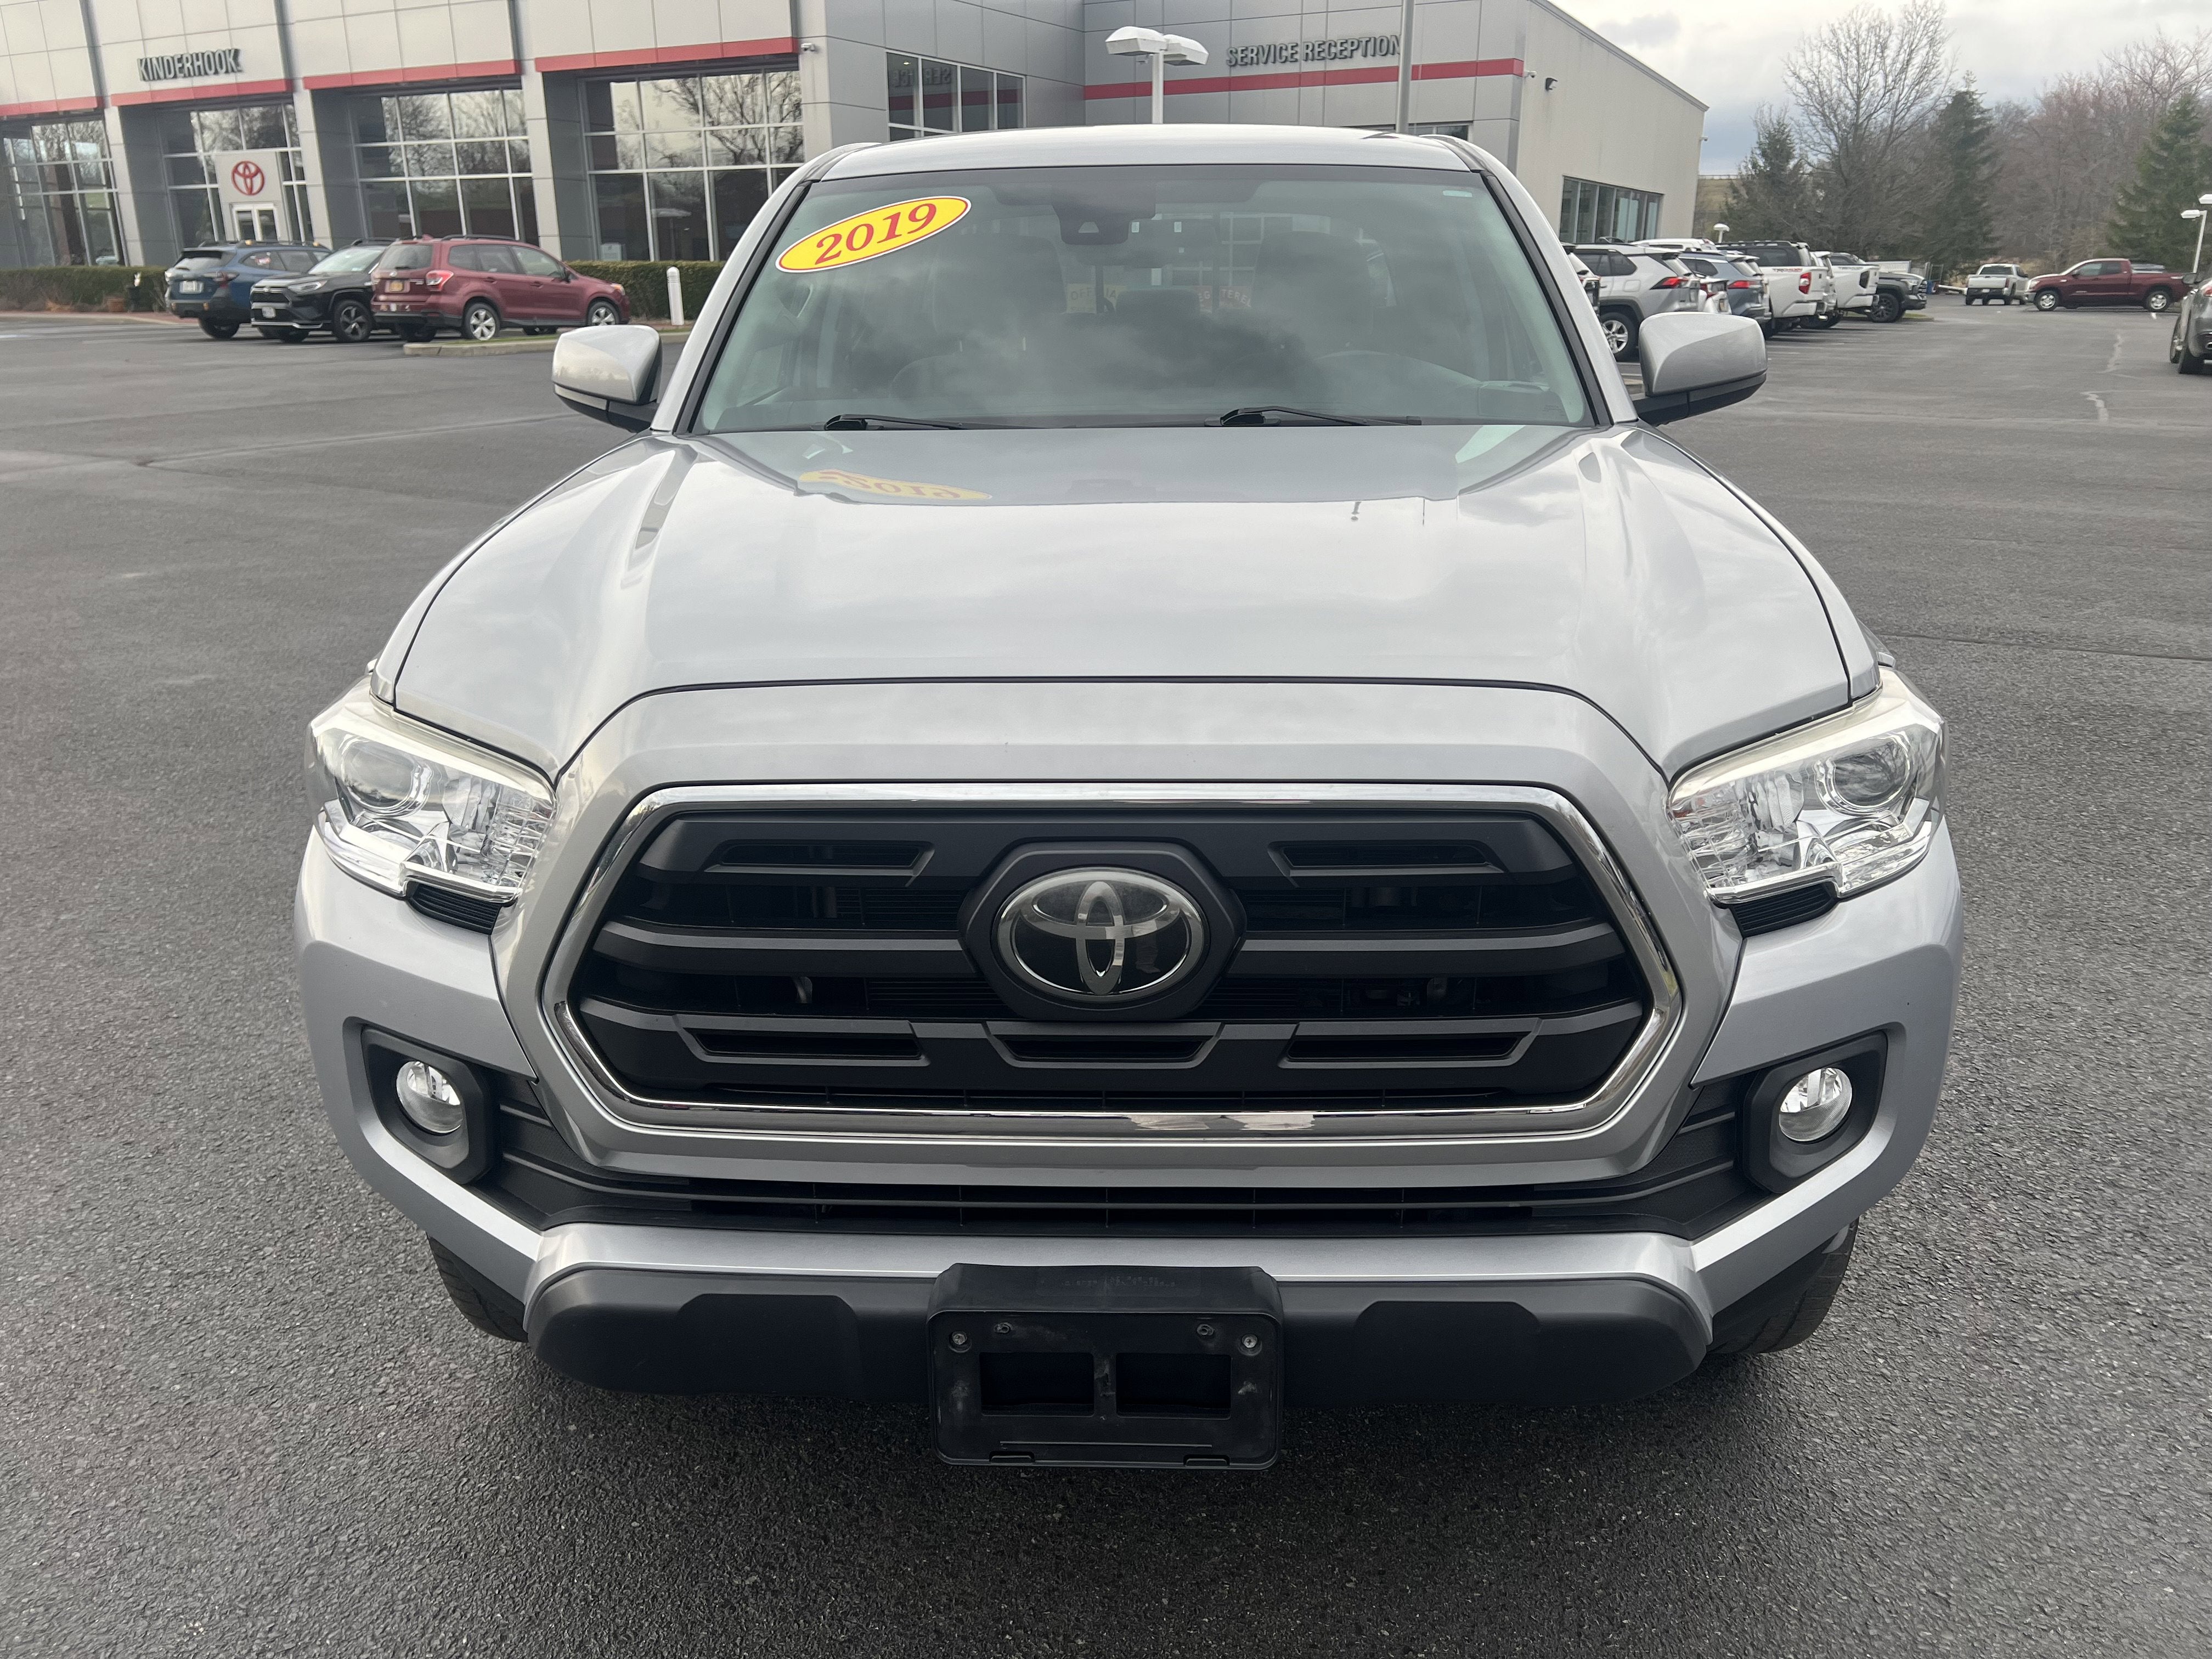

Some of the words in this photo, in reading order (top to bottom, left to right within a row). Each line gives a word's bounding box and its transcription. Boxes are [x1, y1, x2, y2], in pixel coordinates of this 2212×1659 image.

[137, 49, 242, 82] KINDERHOOK
[1226, 43, 1299, 66] SERVICE
[1303, 35, 1401, 61] RECEPTION
[815, 203, 936, 265] 2019
